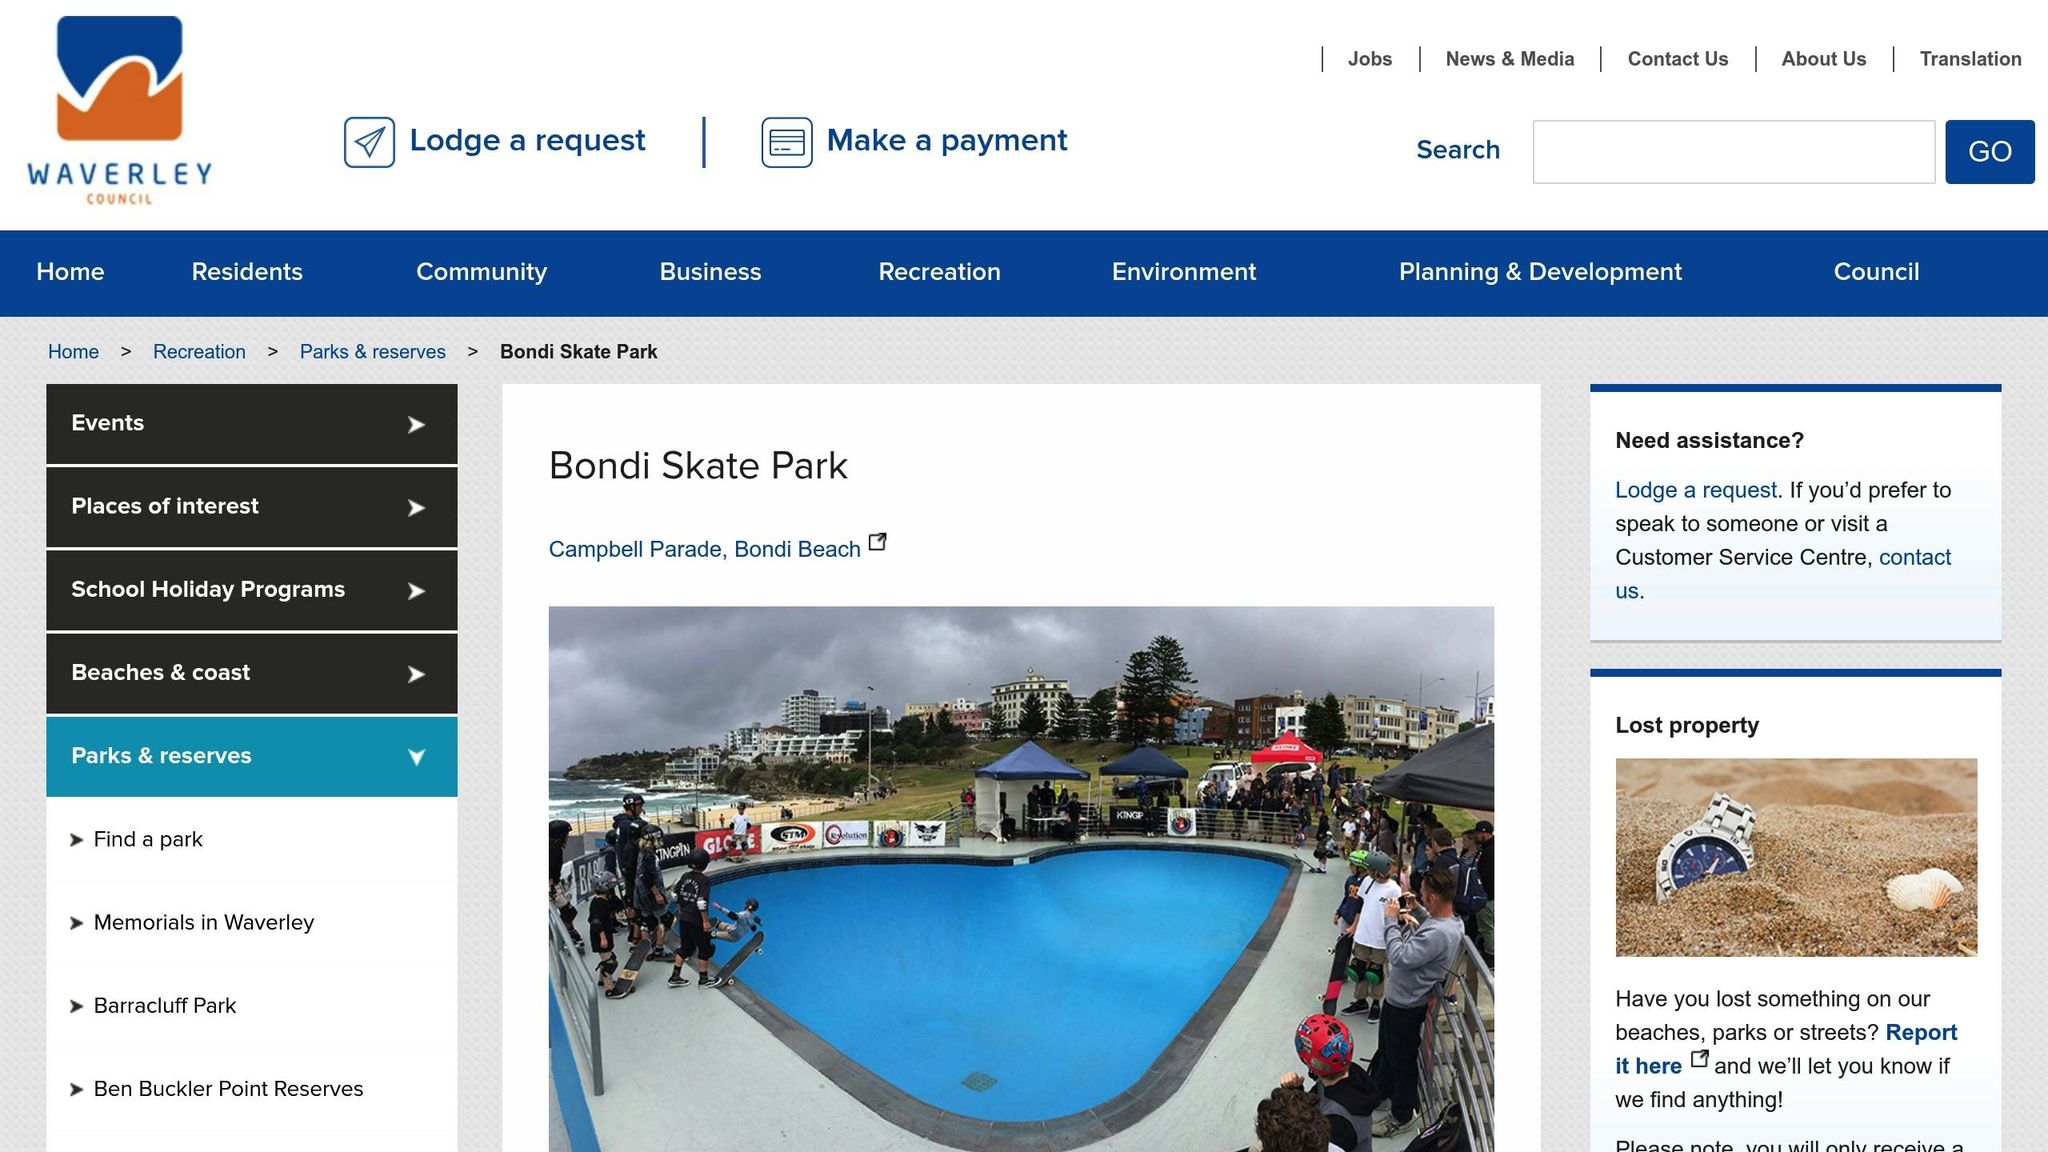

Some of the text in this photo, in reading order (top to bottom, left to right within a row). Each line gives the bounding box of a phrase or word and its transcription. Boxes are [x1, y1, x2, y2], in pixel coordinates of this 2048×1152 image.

[1347, 50, 1393, 67] Jobs
[1446, 50, 1575, 67] News & Media
[1628, 50, 1729, 67] Contact Us
[1781, 50, 1867, 67] About Us
[1919, 50, 2022, 67] Translation
[410, 127, 647, 157] Lodge a request
[827, 127, 1069, 157] Make a payment
[1416, 139, 1500, 160] Search
[1968, 140, 2013, 163] GO
[26, 162, 212, 186] WAVERLEY
[87, 193, 151, 205] COUNCIL
[37, 261, 105, 281] Home
[192, 260, 304, 281] Residents
[415, 261, 548, 286] Community
[660, 261, 762, 281] Business
[879, 261, 1001, 281] Recreation
[1112, 261, 1257, 281] Environment
[1400, 260, 1683, 286] Planning & Development
[1833, 261, 1920, 281] Council
[48, 343, 100, 360] Home
[153, 343, 246, 360] Recreation
[300, 343, 447, 360] Parks & reserves
[500, 343, 658, 360] Bondi Skate Park
[72, 413, 145, 432] Events
[1616, 431, 1805, 449] Need assistance?
[551, 449, 849, 480] Bondi Skate Park
[1616, 480, 1952, 504] Lodge a request. If you’d prefer to
[72, 496, 260, 515] Places of interest
[1615, 514, 1888, 537] speak to someone or visit a
[548, 539, 861, 563] Campbell Parade, Bondi Beach
[1615, 548, 1952, 569] Customer Service Centre, contact
[71, 579, 346, 603] School Holiday Programs
[1615, 585, 1645, 600] us.
[72, 663, 251, 681] Beaches & coast
[1616, 716, 1760, 739] Lost property
[71, 746, 252, 765] Parks & reserves
[94, 830, 204, 852] Find a park
[703, 833, 756, 855] GLOE
[780, 830, 805, 841] STM
[94, 913, 316, 935] Memorials in Waverley
[94, 996, 237, 1014] Barracluff Park
[1616, 989, 1932, 1012] Have you lost something on our
[1616, 1023, 1959, 1046] beaches, parks or streets? Report
[1615, 1056, 1952, 1080] it here and we’ll let you know if
[94, 1079, 364, 1097] Ben Buckler Point Reserves
[1614, 1090, 1783, 1113] we find anything!
[1616, 1140, 1684, 1152] Please
[1787, 1140, 1819, 1152] will
[1873, 1140, 1946, 1152] receive
